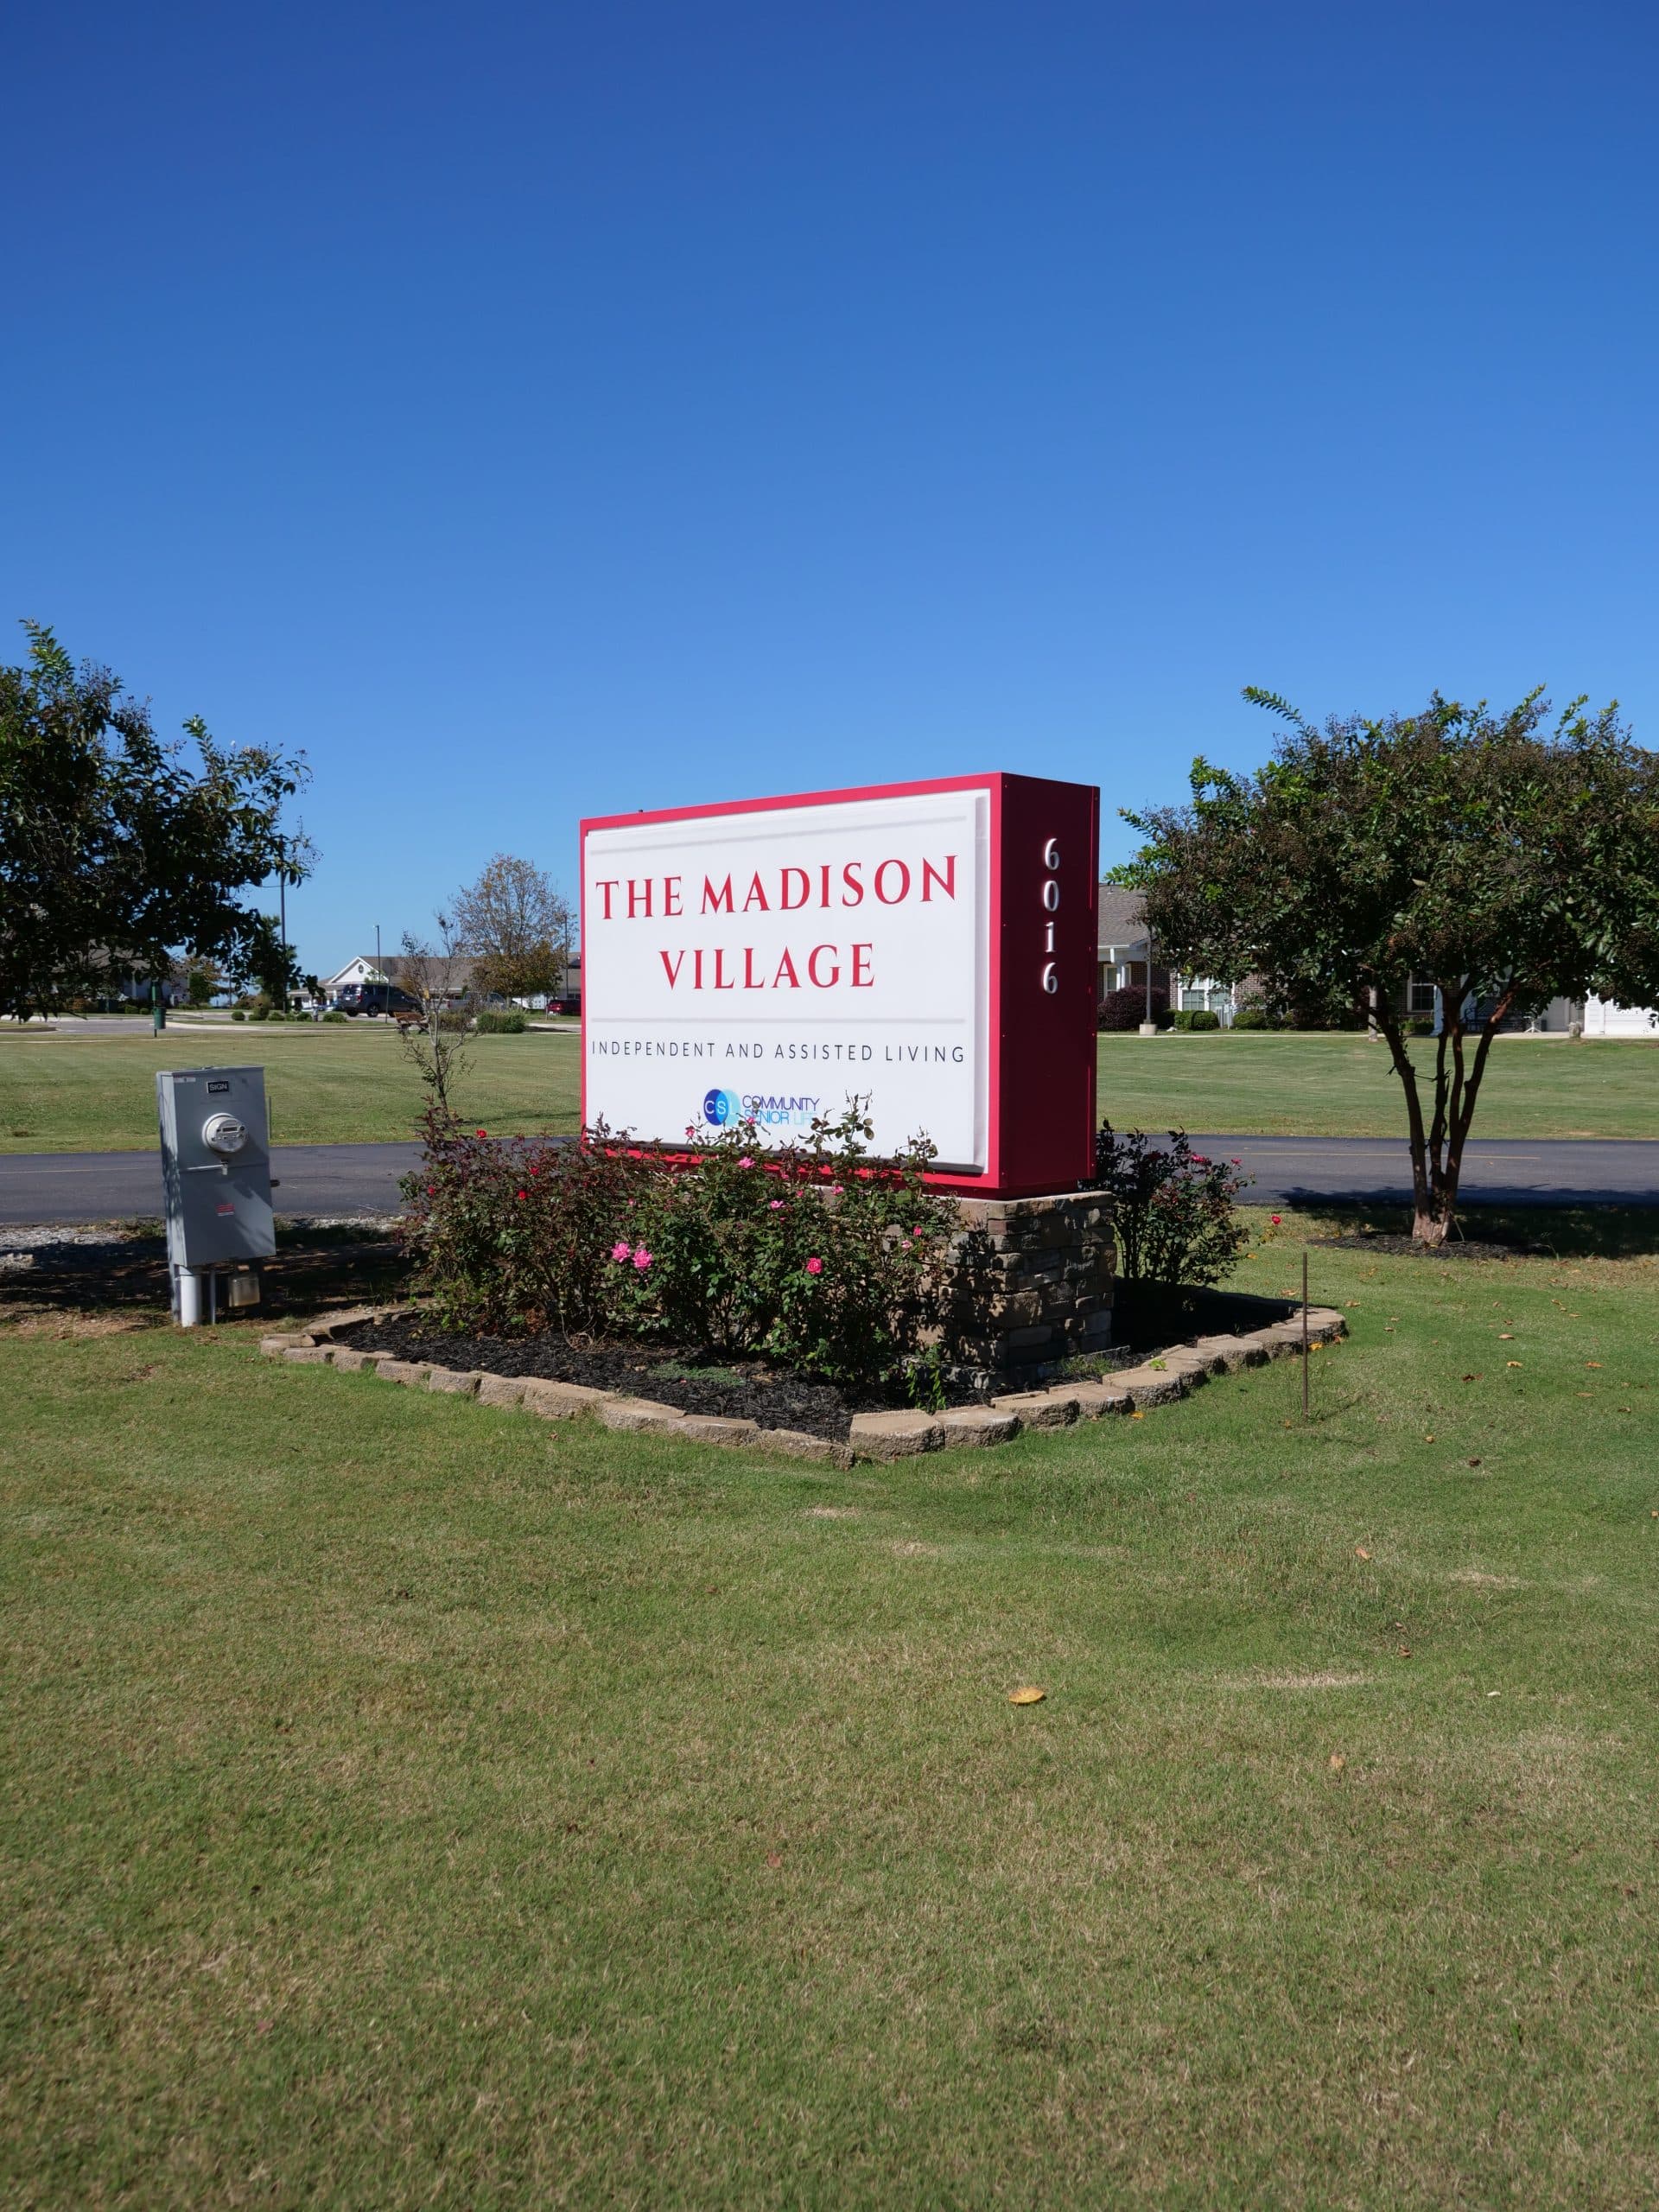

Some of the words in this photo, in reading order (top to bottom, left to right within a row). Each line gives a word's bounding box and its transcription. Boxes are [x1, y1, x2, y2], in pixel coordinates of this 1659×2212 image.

[595, 876, 683, 920] THE
[701, 855, 959, 914] MADISON
[1043, 837, 1060, 995] 6016
[659, 943, 875, 990] VILLAGE
[592, 1041, 715, 1058] INDEPENDENT
[725, 1043, 763, 1058] AND
[774, 1044, 872, 1061] ASSISTED
[886, 1046, 964, 1063] LIVING
[209, 1083, 227, 1091] SIGN
[704, 1100, 738, 1116] CSL
[742, 1095, 820, 1112] COMMUNITY
